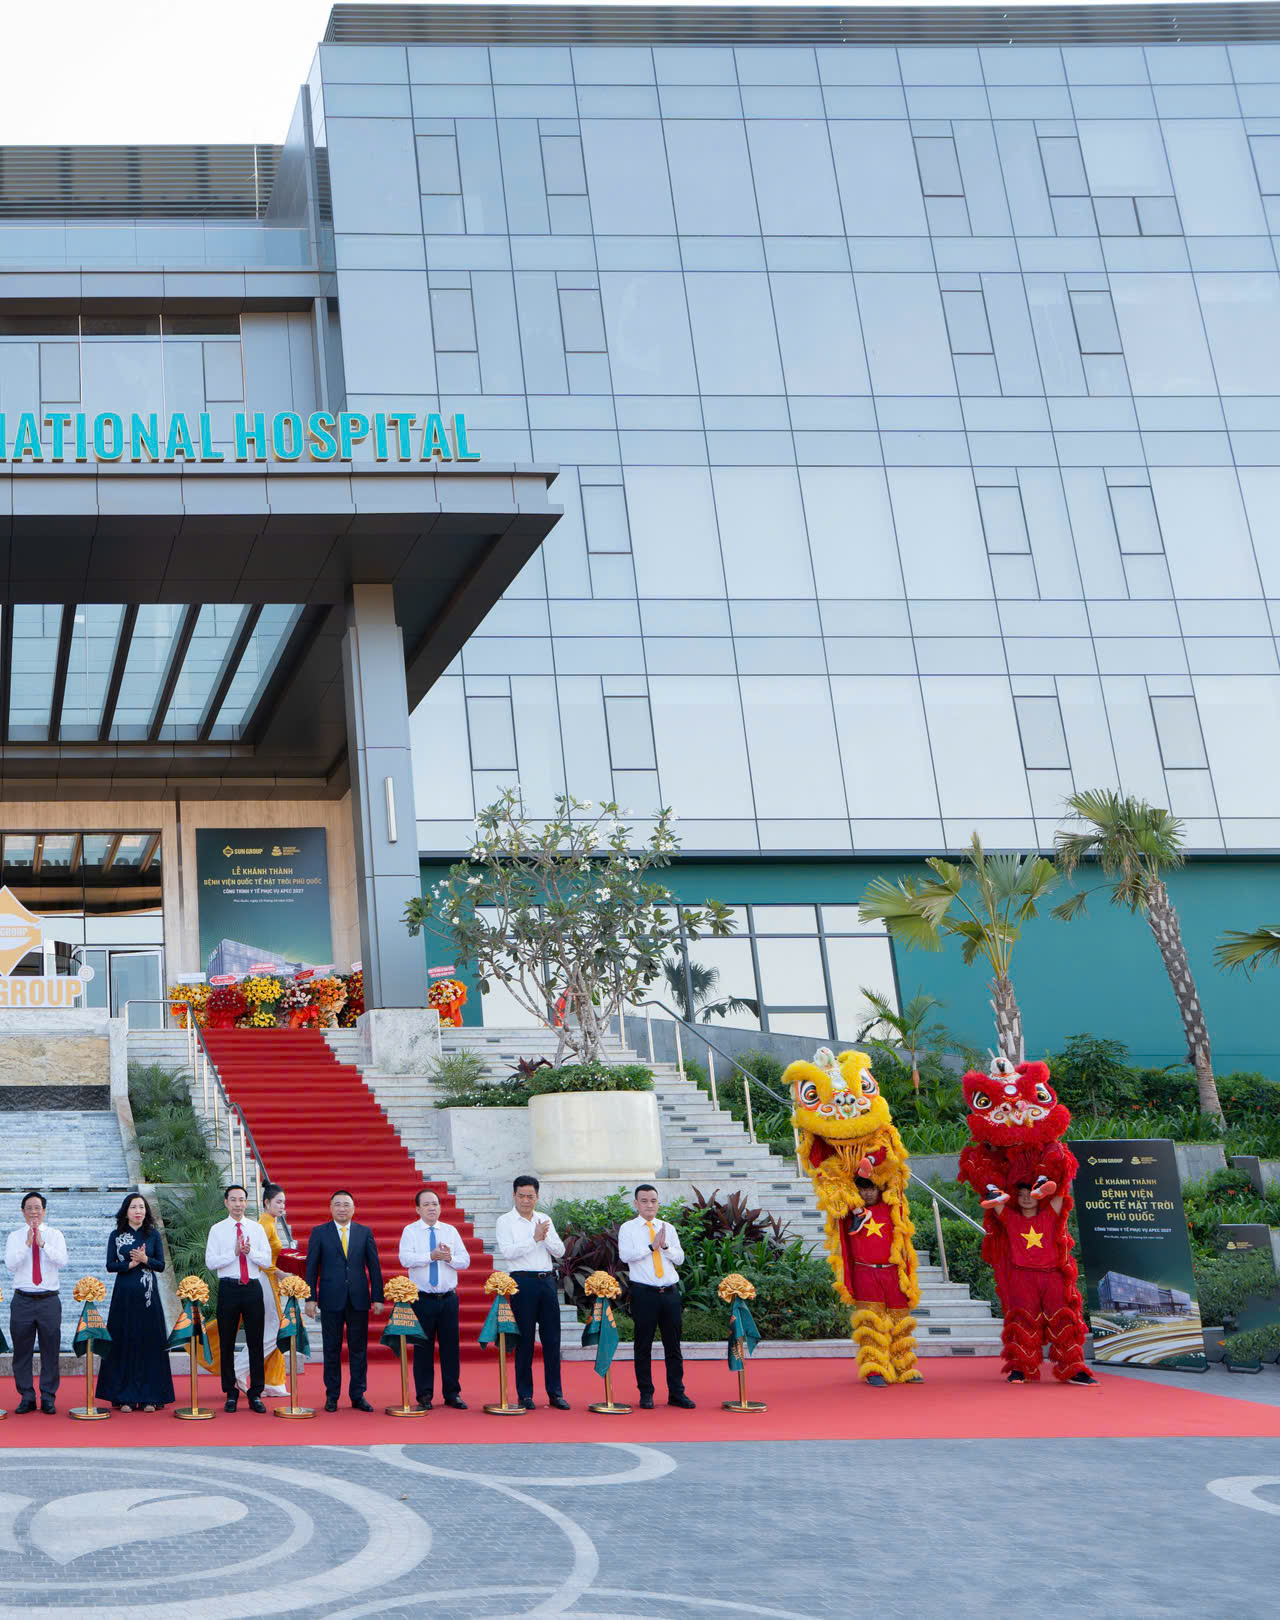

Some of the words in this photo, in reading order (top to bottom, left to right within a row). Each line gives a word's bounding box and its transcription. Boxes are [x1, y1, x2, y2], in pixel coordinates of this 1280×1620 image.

[234, 411, 482, 462] HOSPITAL
[0, 928, 28, 936] GROUP
[1102, 1188, 1128, 1200] BỆNH
[1130, 1188, 1153, 1200] VIỆN
[1086, 1200, 1111, 1210] QUỐC
[1114, 1200, 1126, 1210] TẾ
[1128, 1202, 1148, 1212] MẶT
[1150, 1200, 1174, 1210] TRỜI
[1106, 1211, 1126, 1220] PHÚ
[1128, 1210, 1155, 1221] QUỐC
